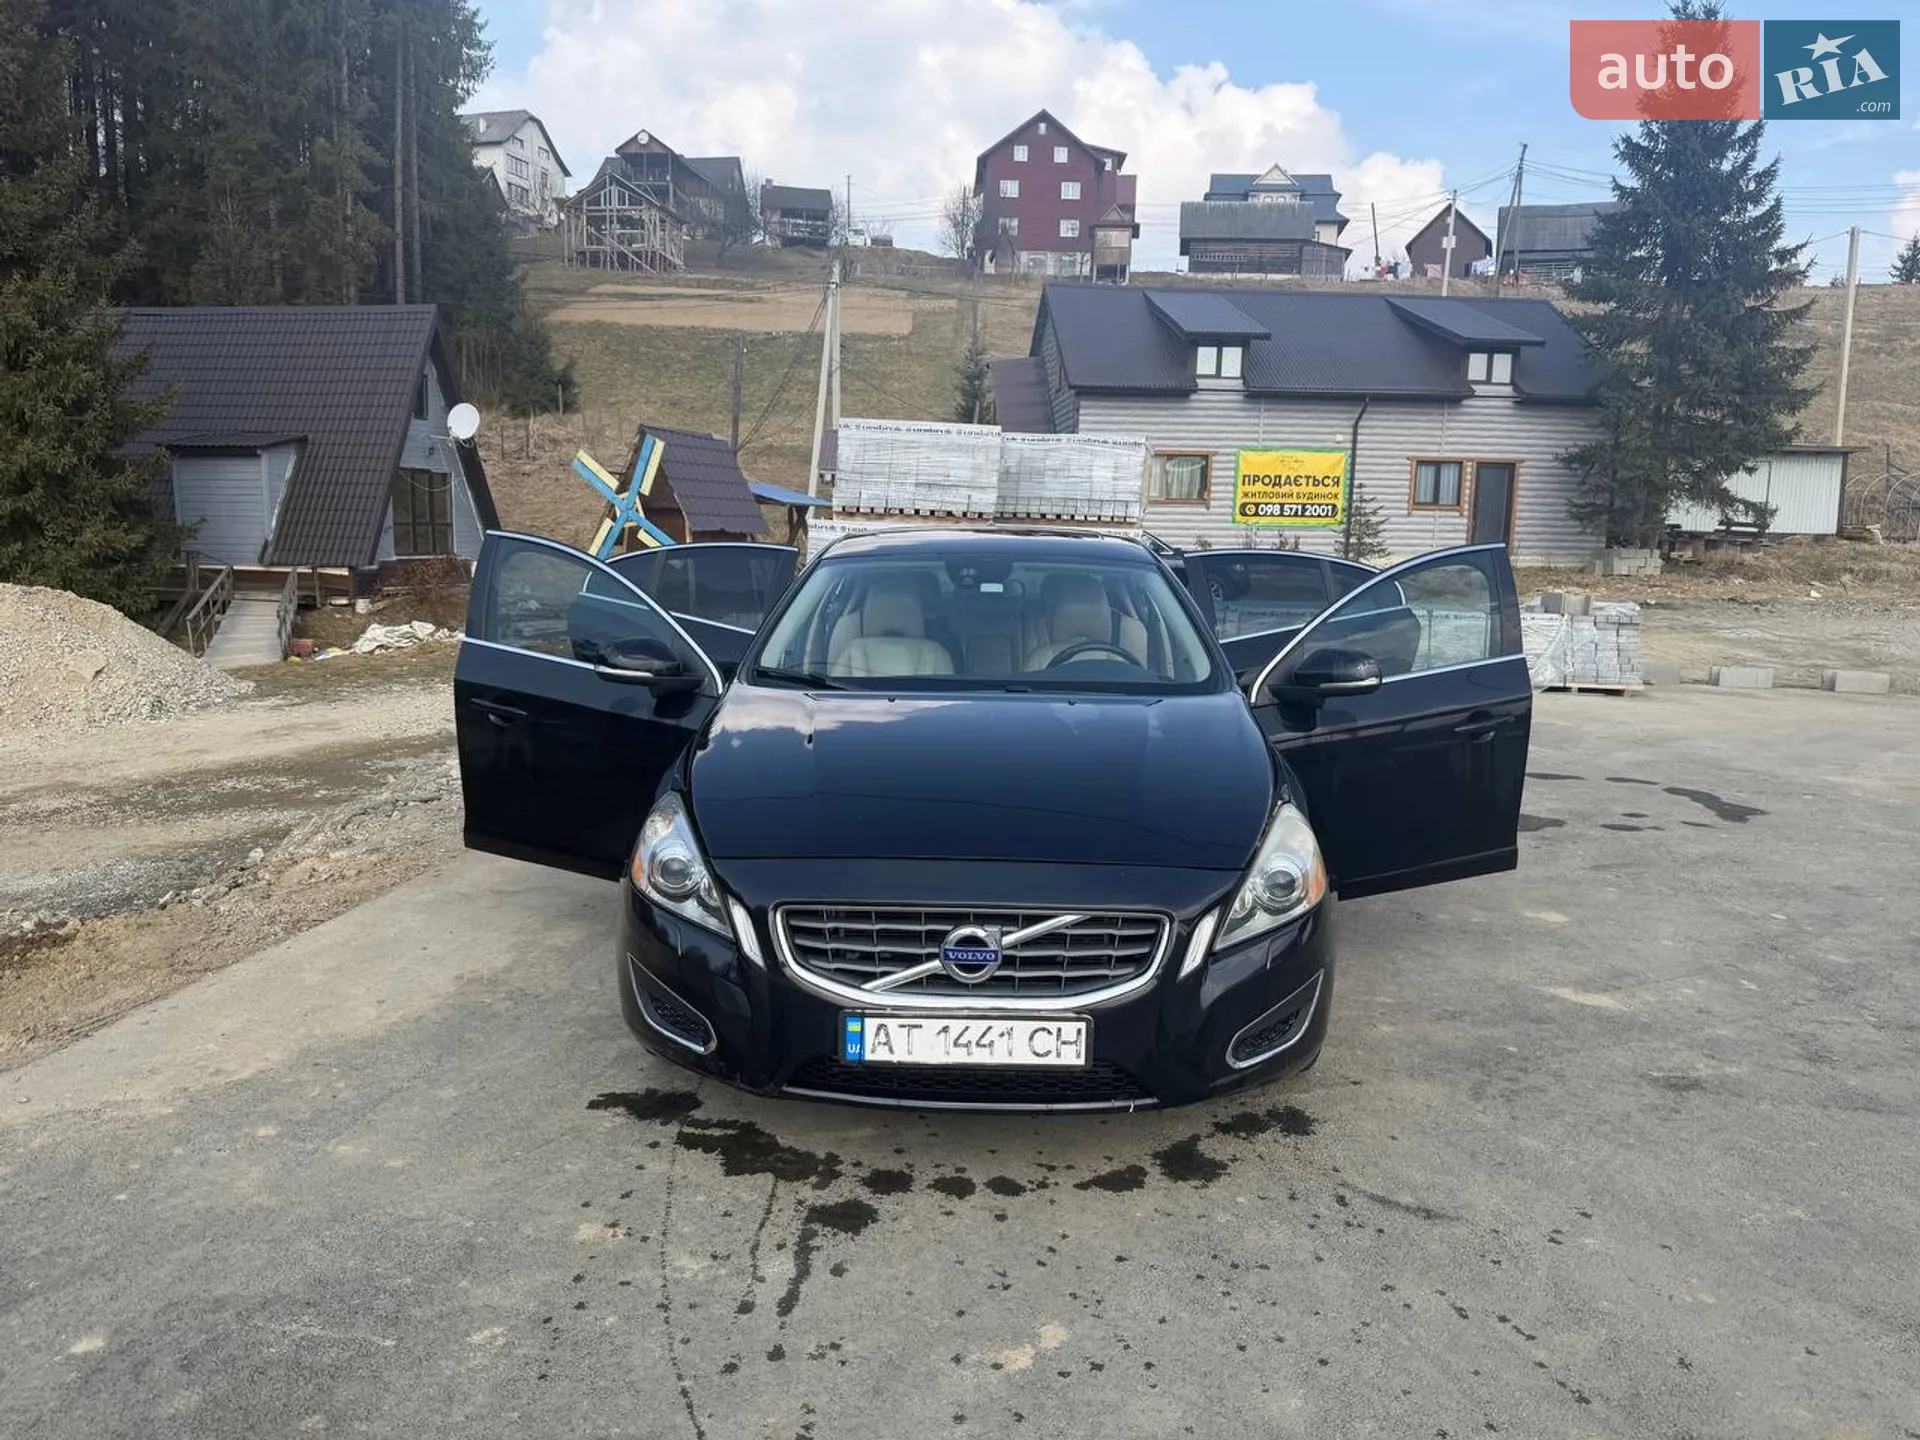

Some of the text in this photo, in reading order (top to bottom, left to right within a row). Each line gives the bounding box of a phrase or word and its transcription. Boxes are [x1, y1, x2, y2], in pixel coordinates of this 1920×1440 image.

[1241, 474, 1341, 489] ПРОДАЄТЬСЯ
[1241, 490, 1340, 501] ЖИТЛОВИЙ БУДИНОК
[1258, 504, 1332, 517] 098 571 2001
[946, 950, 996, 961] VOLVO
[870, 1022, 1083, 1059] AT 1441 CH
